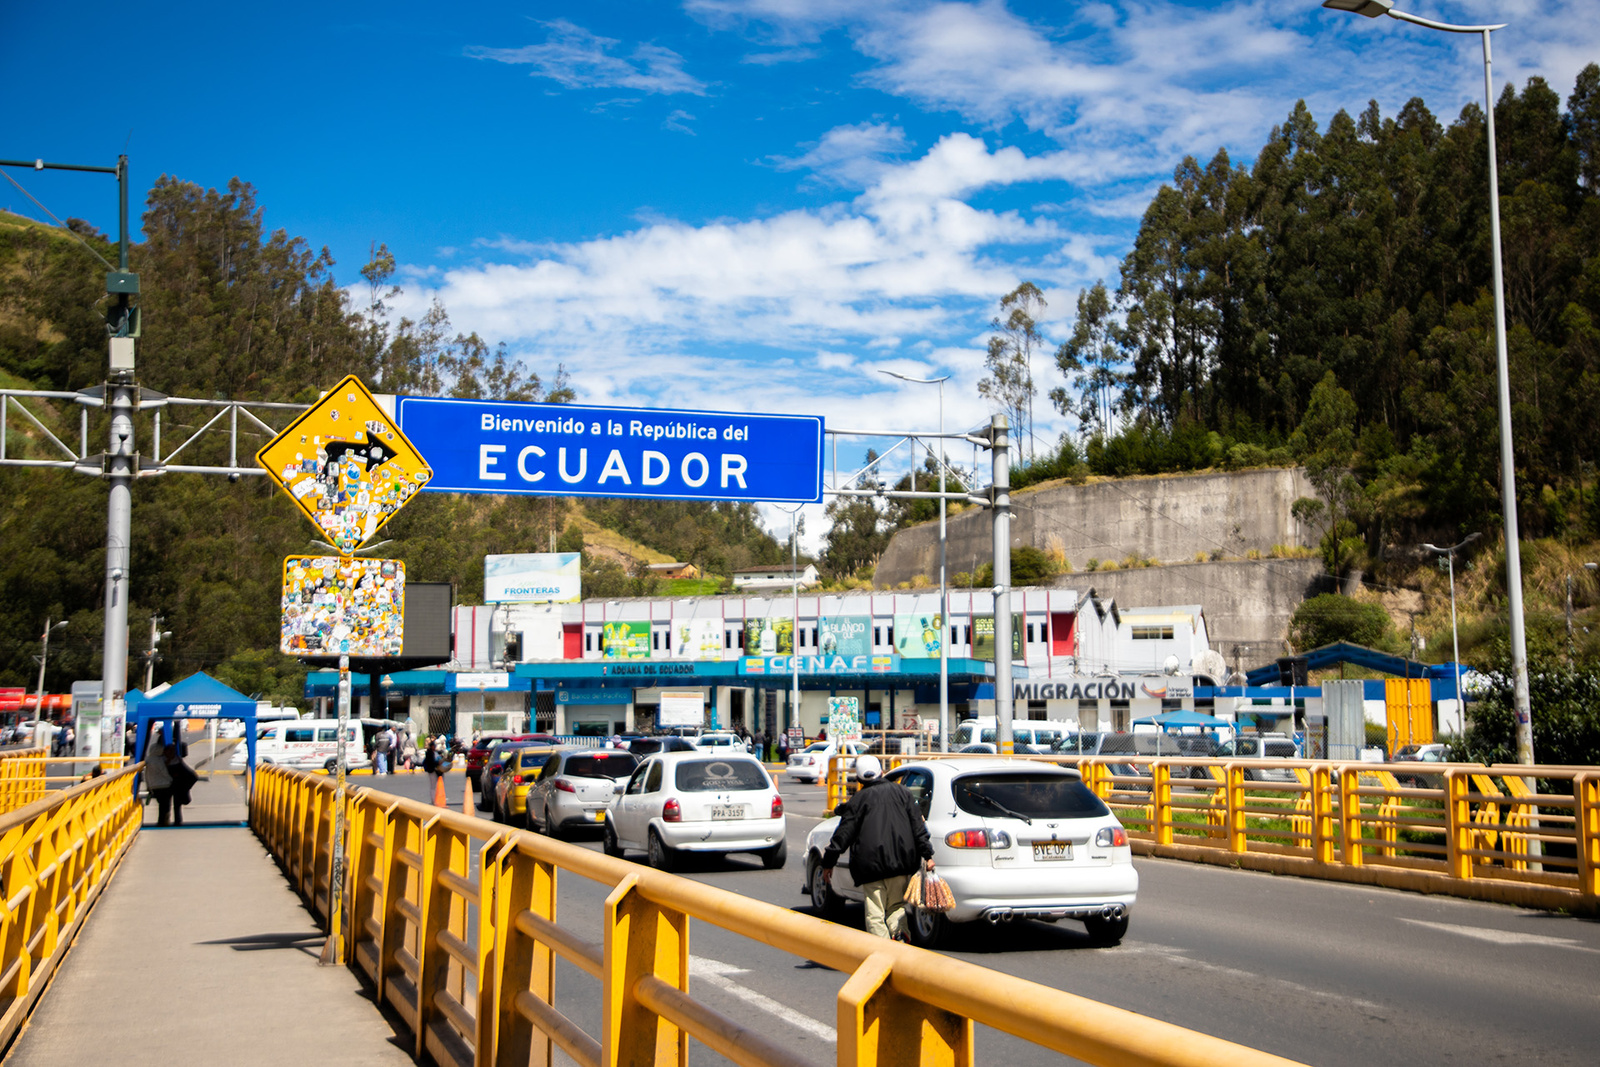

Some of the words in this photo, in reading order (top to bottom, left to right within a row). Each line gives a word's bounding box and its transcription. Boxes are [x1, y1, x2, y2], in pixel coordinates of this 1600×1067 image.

[480, 413, 585, 434] Bienvenido
[590, 421, 601, 435] a
[607, 418, 624, 437] la
[629, 420, 719, 441] República
[722, 424, 749, 442] del
[478, 444, 749, 488] ECUADOR
[504, 587, 560, 595] FRONTERAS
[830, 623, 865, 632] BLANCO
[842, 632, 855, 640] QUE
[769, 655, 867, 669] CENAF
[611, 666, 641, 674] ADUANA
[643, 666, 657, 674] DEL
[659, 665, 694, 674] ECUADOR
[1015, 679, 1135, 699] MIGRACIÓN
[713, 809, 744, 817] PPA-3157
